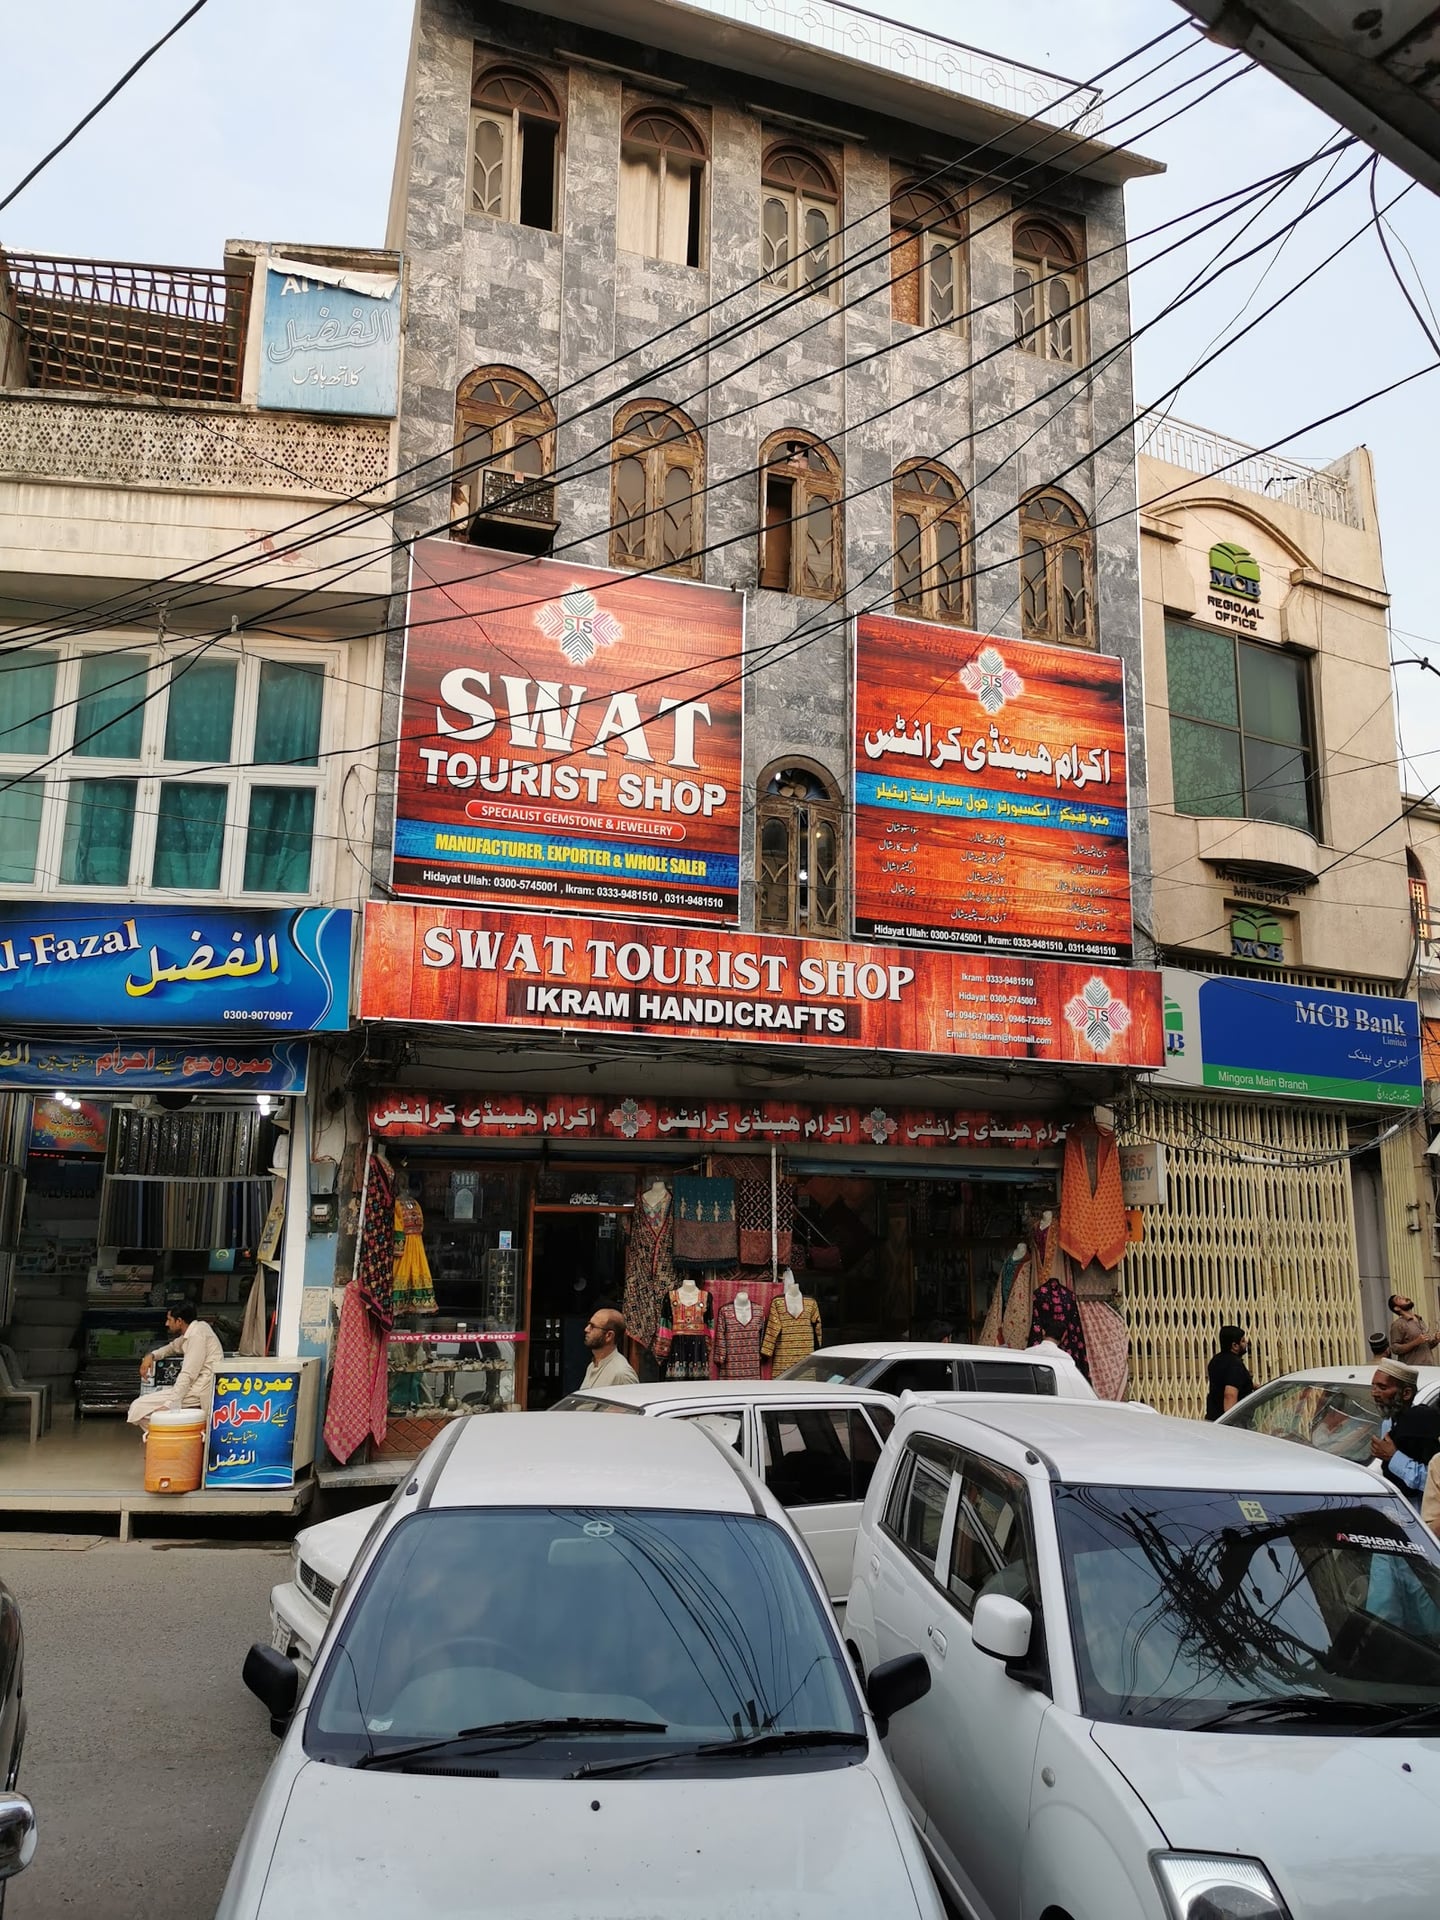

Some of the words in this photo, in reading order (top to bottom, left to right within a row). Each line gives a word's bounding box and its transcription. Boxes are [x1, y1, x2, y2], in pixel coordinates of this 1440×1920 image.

[267, 306, 394, 364] الفضل
[1210, 569, 1261, 597] MCB
[1215, 611, 1258, 631] OFFICE
[436, 668, 712, 770] SWAT
[419, 748, 607, 803] TOURIST
[618, 773, 727, 816] SHOP
[481, 805, 542, 821] SPECIALIST
[543, 811, 603, 828] GEMSTONE
[605, 819, 614, 830] &
[616, 821, 673, 836] JEWELLERY
[435, 833, 545, 862] MANUFACTURER,
[547, 845, 611, 867] EXPORTER
[612, 854, 623, 868] &
[624, 853, 668, 873] WHOLE
[669, 859, 707, 877] SALER
[423, 870, 461, 885] Hidayat
[463, 873, 491, 886] Ullah:
[493, 877, 558, 892] 0300-5745001
[565, 883, 595, 896] Ikram:
[596, 887, 658, 902] 0333-9481510
[664, 893, 724, 908] 0311-9481510
[1233, 885, 1290, 906] MINGORA
[873, 924, 905, 938] Hidayat
[906, 927, 929, 939] Ullah:
[930, 930, 982, 944] 0300-5745001
[987, 934, 1012, 946] Ikram:
[1012, 937, 1063, 951] 0333-9481510
[1068, 943, 1116, 956] 0311-9481510
[1231, 939, 1284, 963] MCB
[125, 930, 279, 998] الفضل
[422, 927, 575, 977] SWAT
[586, 939, 789, 992] TOURIST
[799, 957, 915, 1001] SHOP
[961, 973, 984, 983] Ikram:
[986, 975, 1034, 987] 0333-9481510
[526, 985, 630, 1019] IKRAM
[639, 995, 846, 1033] HANDICRAFTS
[944, 1009, 957, 1018] Tel:
[990, 994, 1037, 1006] 0300-5745001
[223, 1010, 294, 1021] 0300-9070907
[1295, 1000, 1349, 1029] MCB
[1355, 1008, 1406, 1036] Bank
[946, 1030, 969, 1040] Email:
[971, 1031, 1052, 1045] stsikram@hotmail.com
[1383, 1035, 1407, 1047] Limited
[95, 1047, 155, 1077] احرام
[1218, 1070, 1254, 1087] Mingora
[1255, 1074, 1277, 1088] Main
[1278, 1078, 1308, 1091] Branch
[421, 1333, 487, 1341] TOURIST
[213, 1398, 271, 1430] احرام
[208, 1448, 255, 1472] الفضل
[1244, 1507, 1265, 1519] 12
